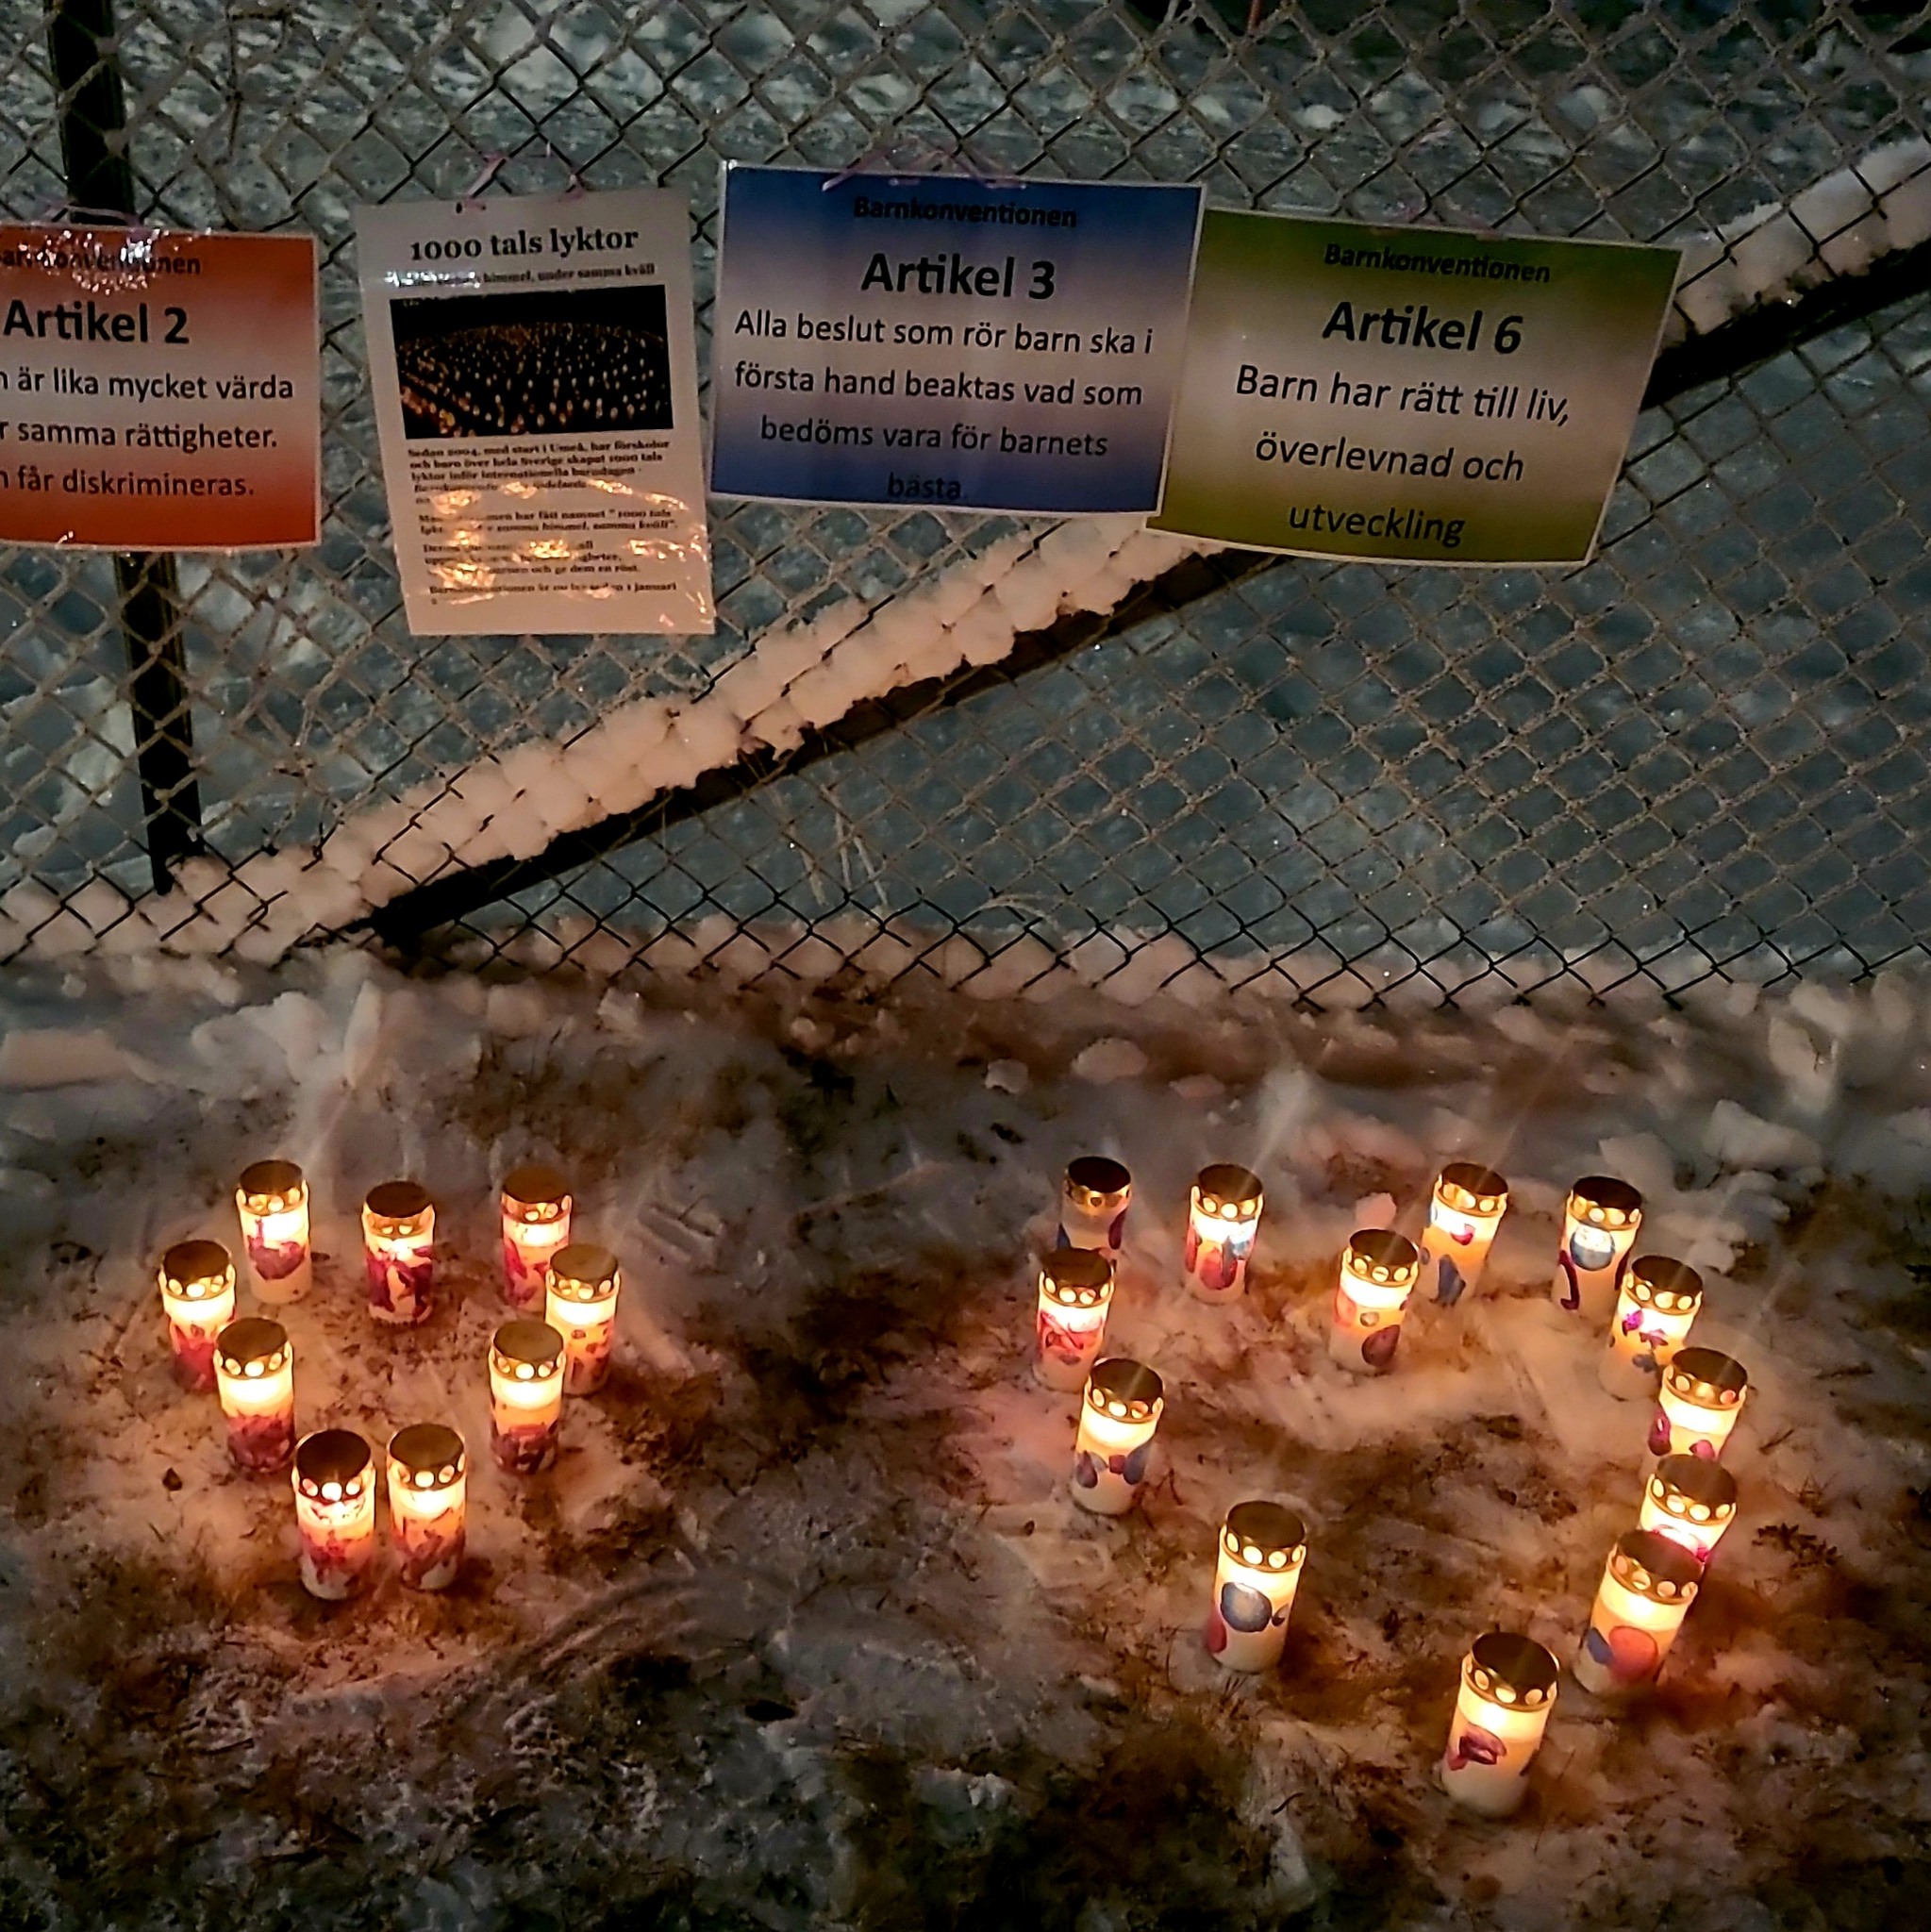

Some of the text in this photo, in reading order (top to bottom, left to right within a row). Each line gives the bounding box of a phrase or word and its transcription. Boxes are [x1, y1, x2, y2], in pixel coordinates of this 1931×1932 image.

[853, 195, 1078, 229] Barnkonventionen
[409, 225, 640, 261] 1000 tals lyktor
[1323, 242, 1552, 284] Barnkonventionen
[860, 252, 1057, 301] Artikel 3
[4, 298, 190, 344] Artikel 2
[734, 308, 1154, 356] Alla beslut som rör barn ska i
[1322, 299, 1524, 355] Artikel 6
[17, 366, 45, 392] är
[53, 368, 99, 395] lika
[108, 374, 208, 402] mycket
[216, 374, 294, 400] värda
[734, 360, 1143, 407] första hand beaktas vad som
[1236, 363, 1570, 428] Barn har rätt till liv,
[18, 422, 116, 447] samma
[125, 423, 278, 455] rättigheter.
[760, 414, 1109, 458] bedöms vara för barnets
[1256, 431, 1524, 482] överlevnad och
[18, 465, 54, 492] får
[62, 468, 255, 497] diskrimineras.
[1289, 504, 1467, 549] utveckling
